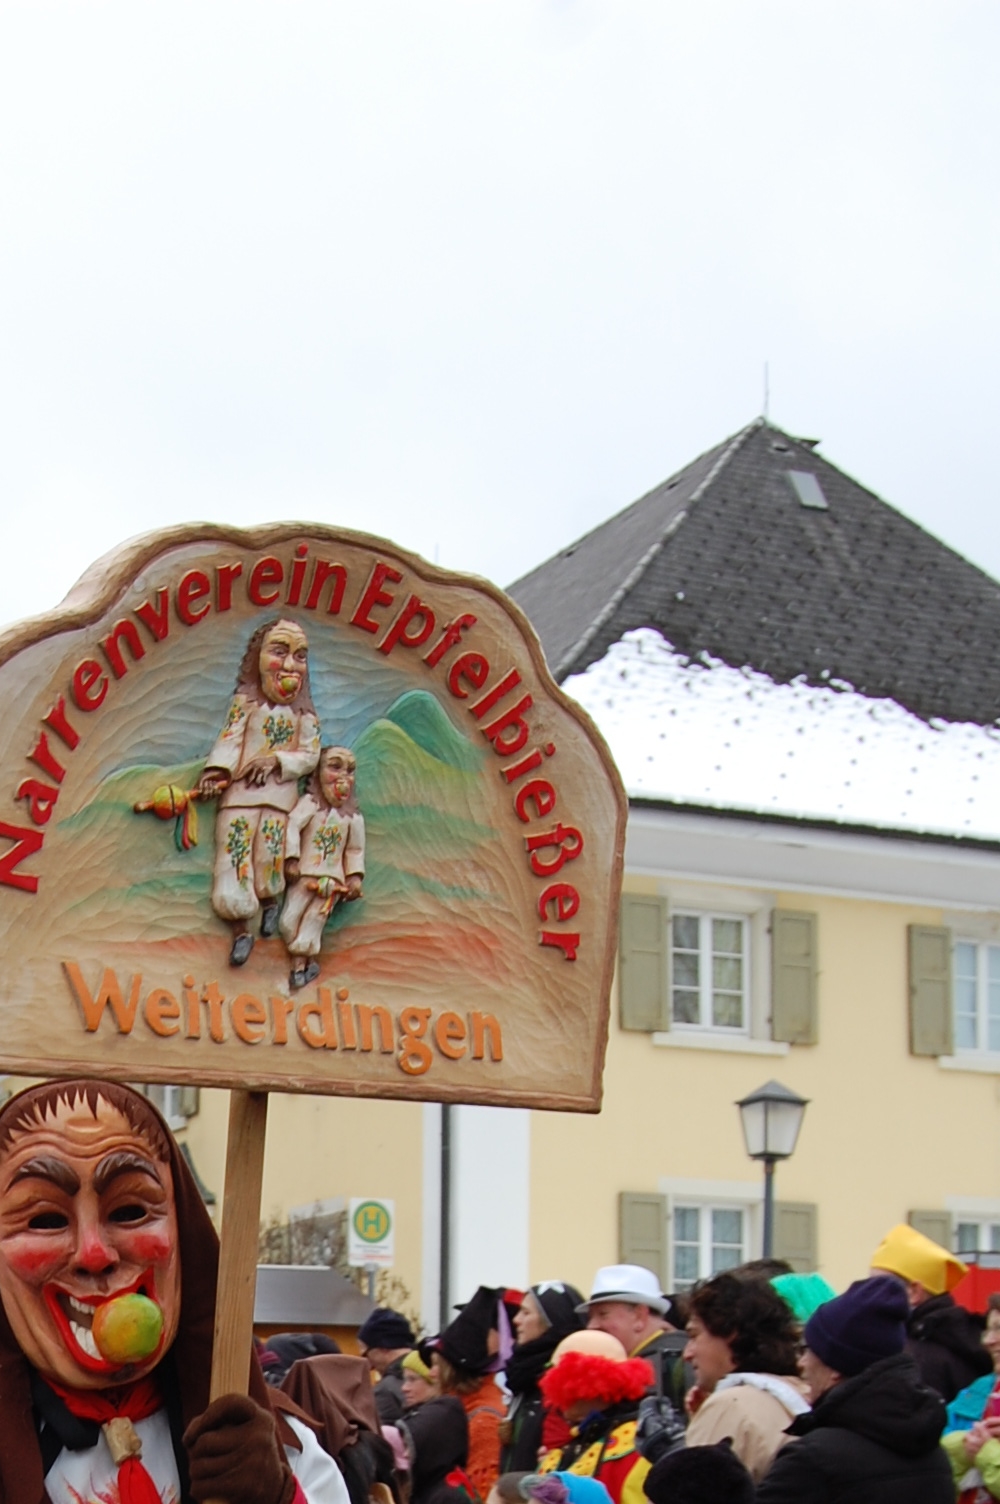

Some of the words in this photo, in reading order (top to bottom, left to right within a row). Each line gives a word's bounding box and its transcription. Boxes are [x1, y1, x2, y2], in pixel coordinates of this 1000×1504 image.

[350, 560, 583, 961] Epfelbießer
[61, 961, 503, 1075] Weiterdingen
[363, 1211, 380, 1233] H
